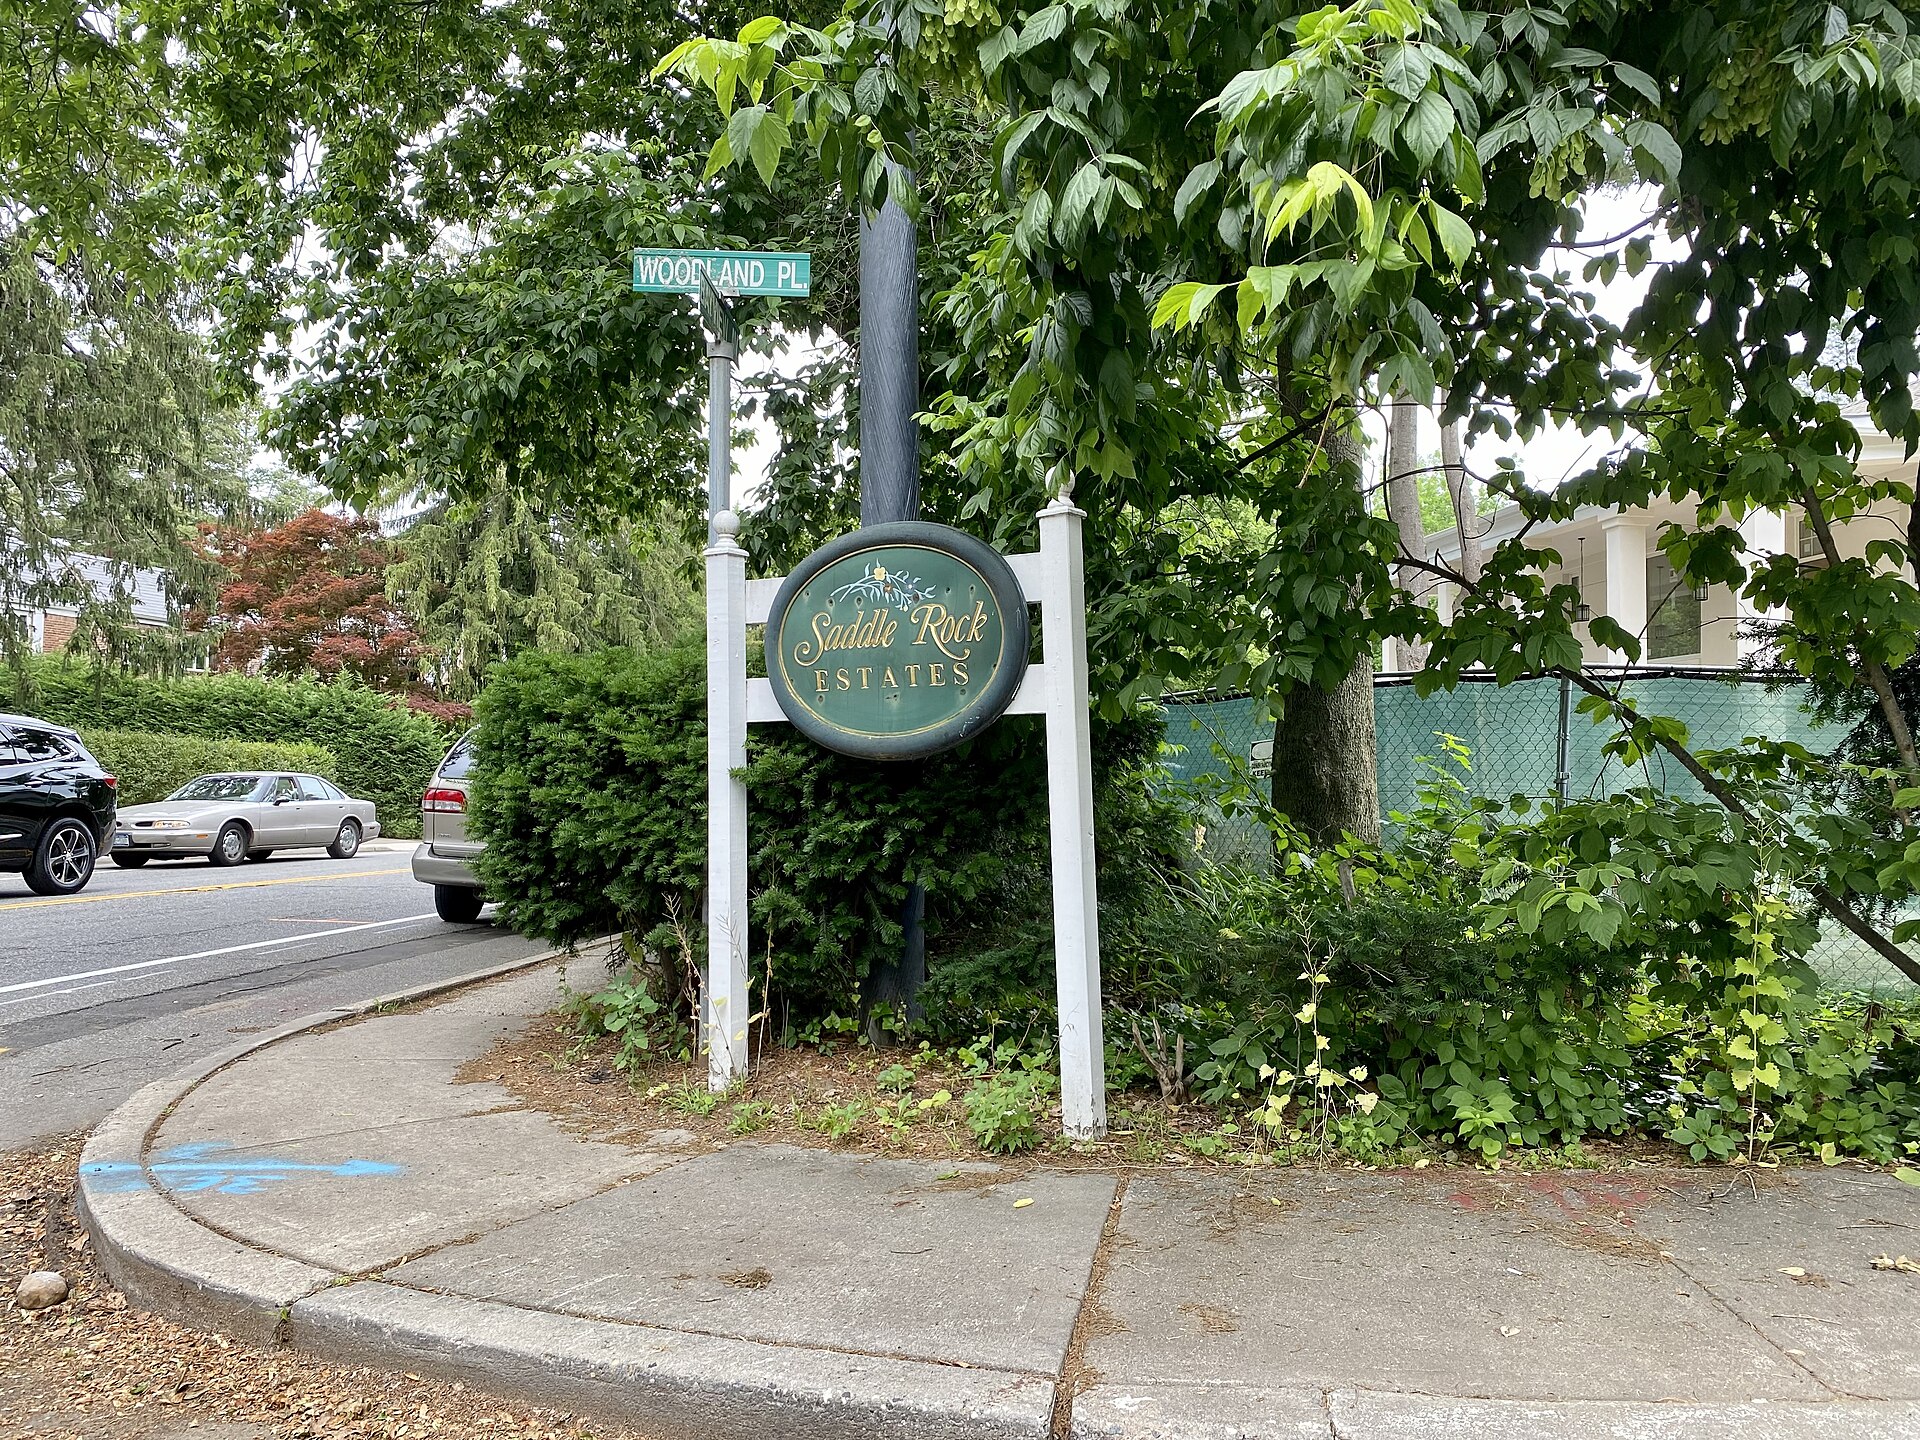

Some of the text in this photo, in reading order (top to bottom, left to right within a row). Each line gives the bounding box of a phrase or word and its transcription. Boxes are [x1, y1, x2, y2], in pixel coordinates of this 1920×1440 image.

[638, 256, 808, 290] WOODLAND PL.
[794, 600, 988, 667] Saddle Rock
[814, 662, 970, 693] ESTATES
